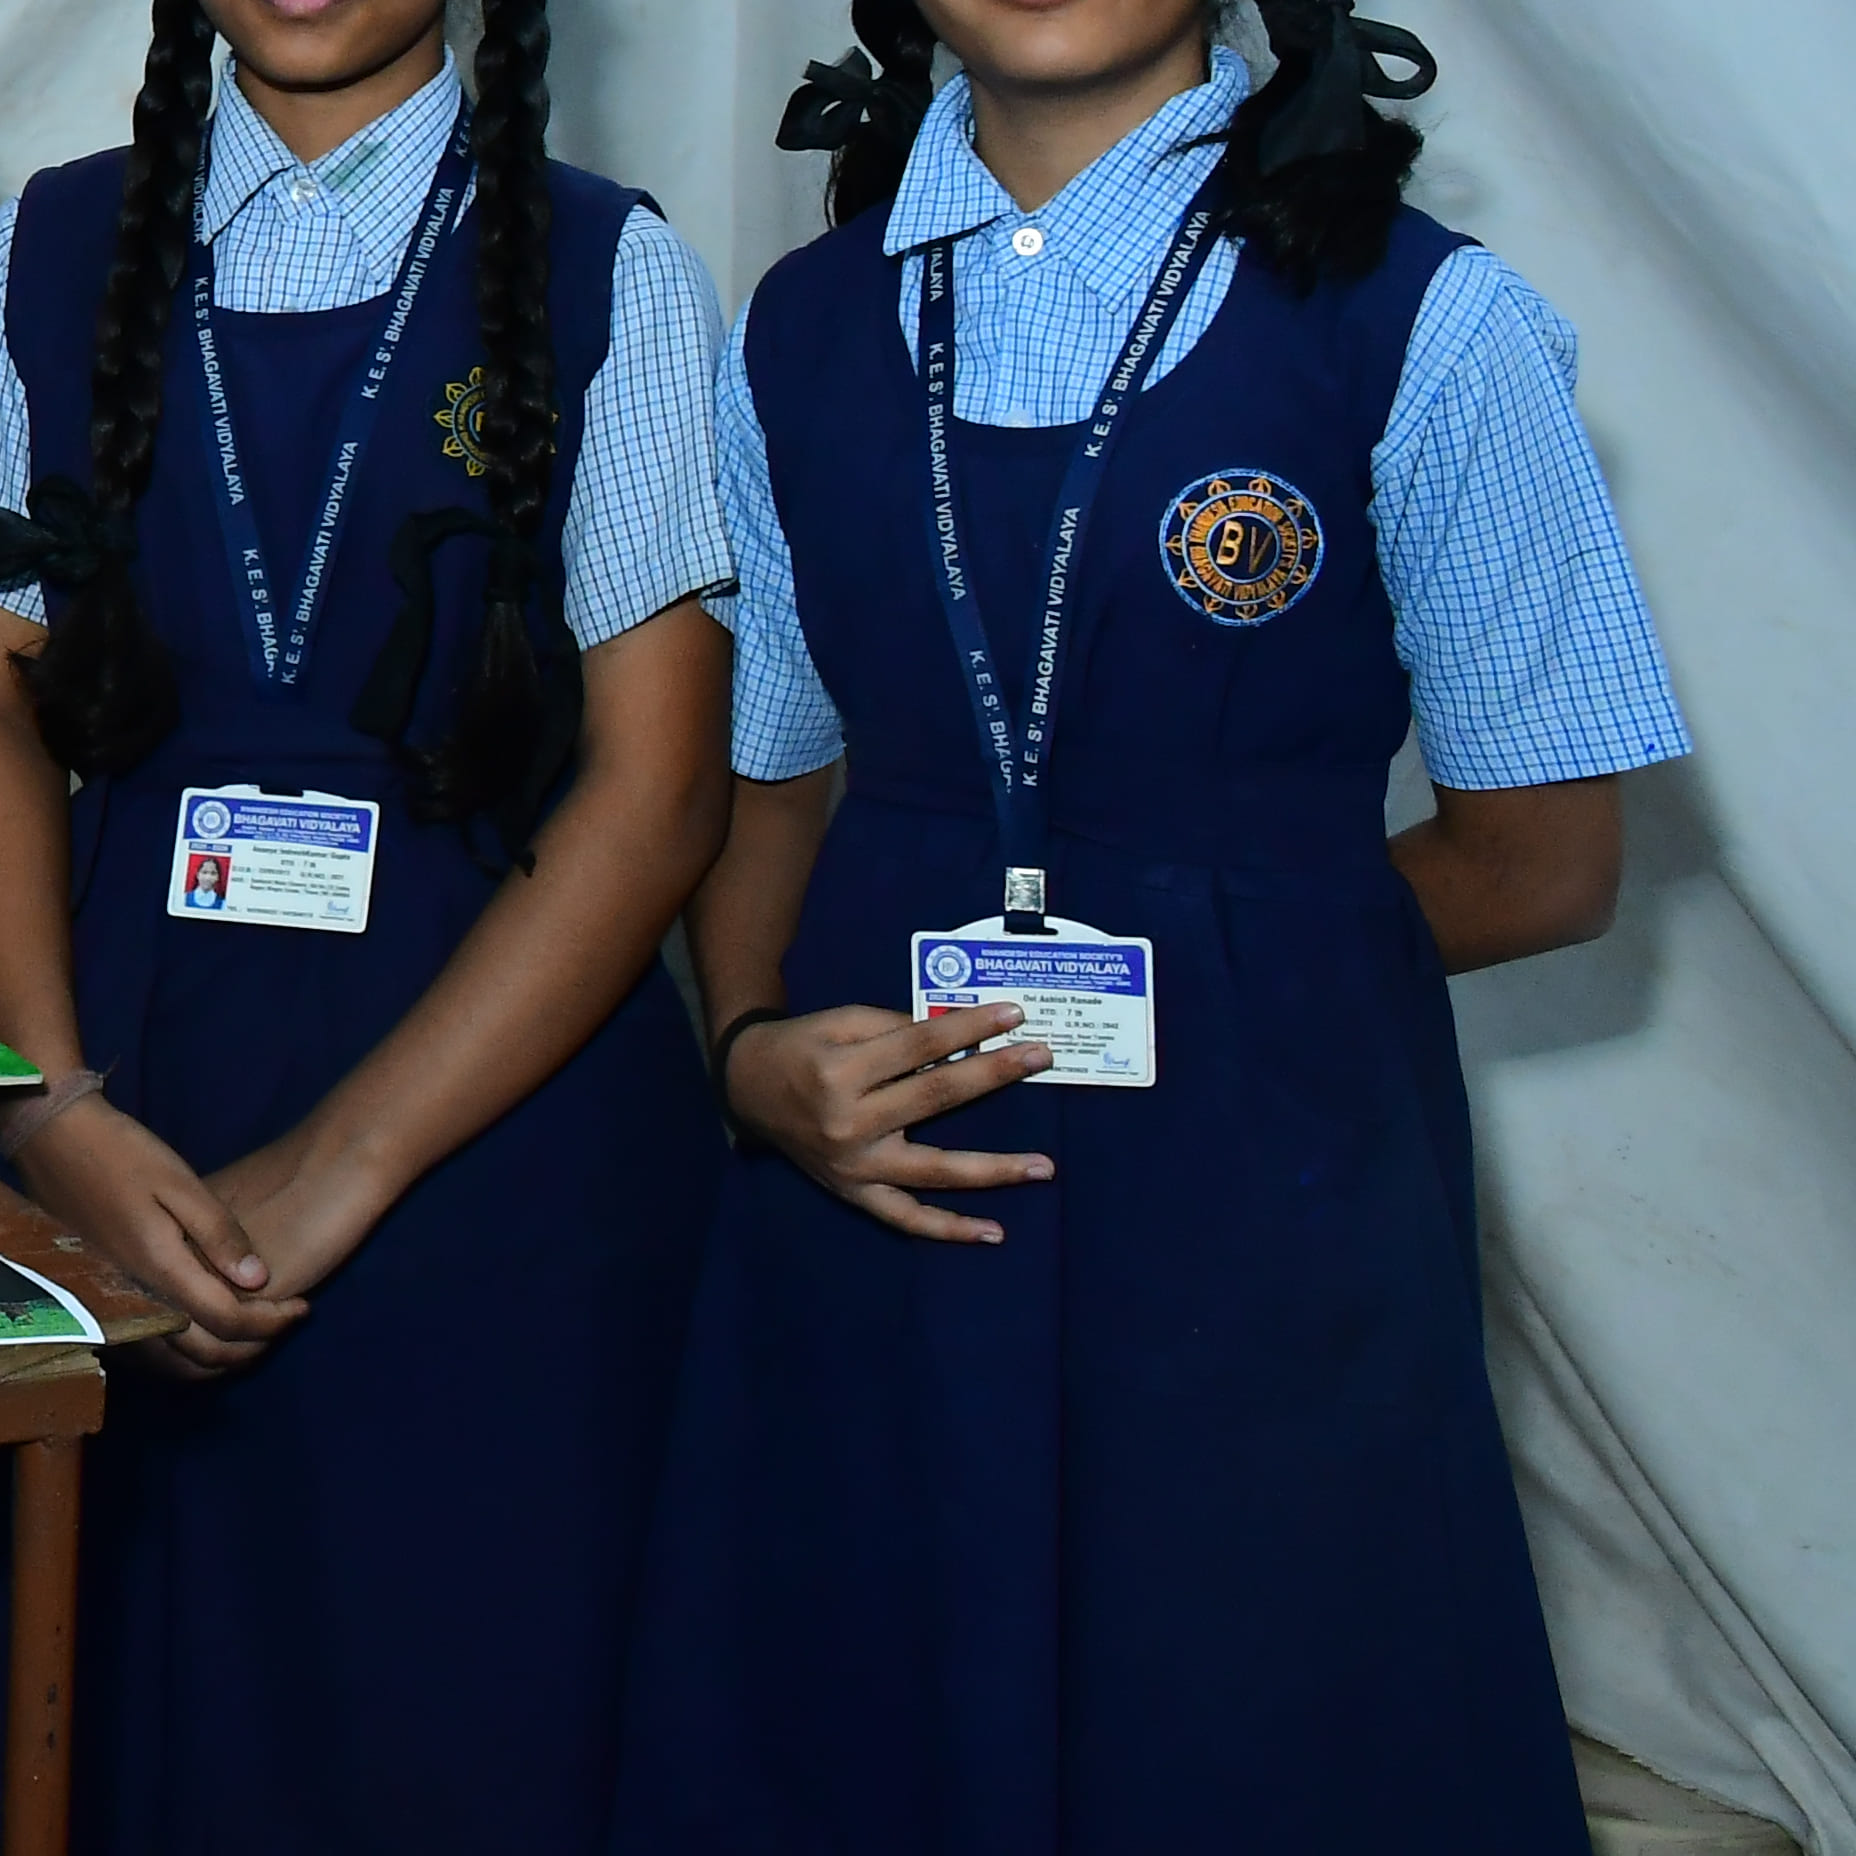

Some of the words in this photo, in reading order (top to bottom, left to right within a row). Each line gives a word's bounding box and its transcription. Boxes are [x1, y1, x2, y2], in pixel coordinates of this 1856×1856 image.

[1046, 506, 1080, 607] VIDYALAYA
[1216, 520, 1273, 573] BV
[1032, 609, 1064, 716] BHAGAVATI
[975, 958, 1052, 972] BHAGAVATI
[1055, 961, 1130, 975] VIDYALAYA
